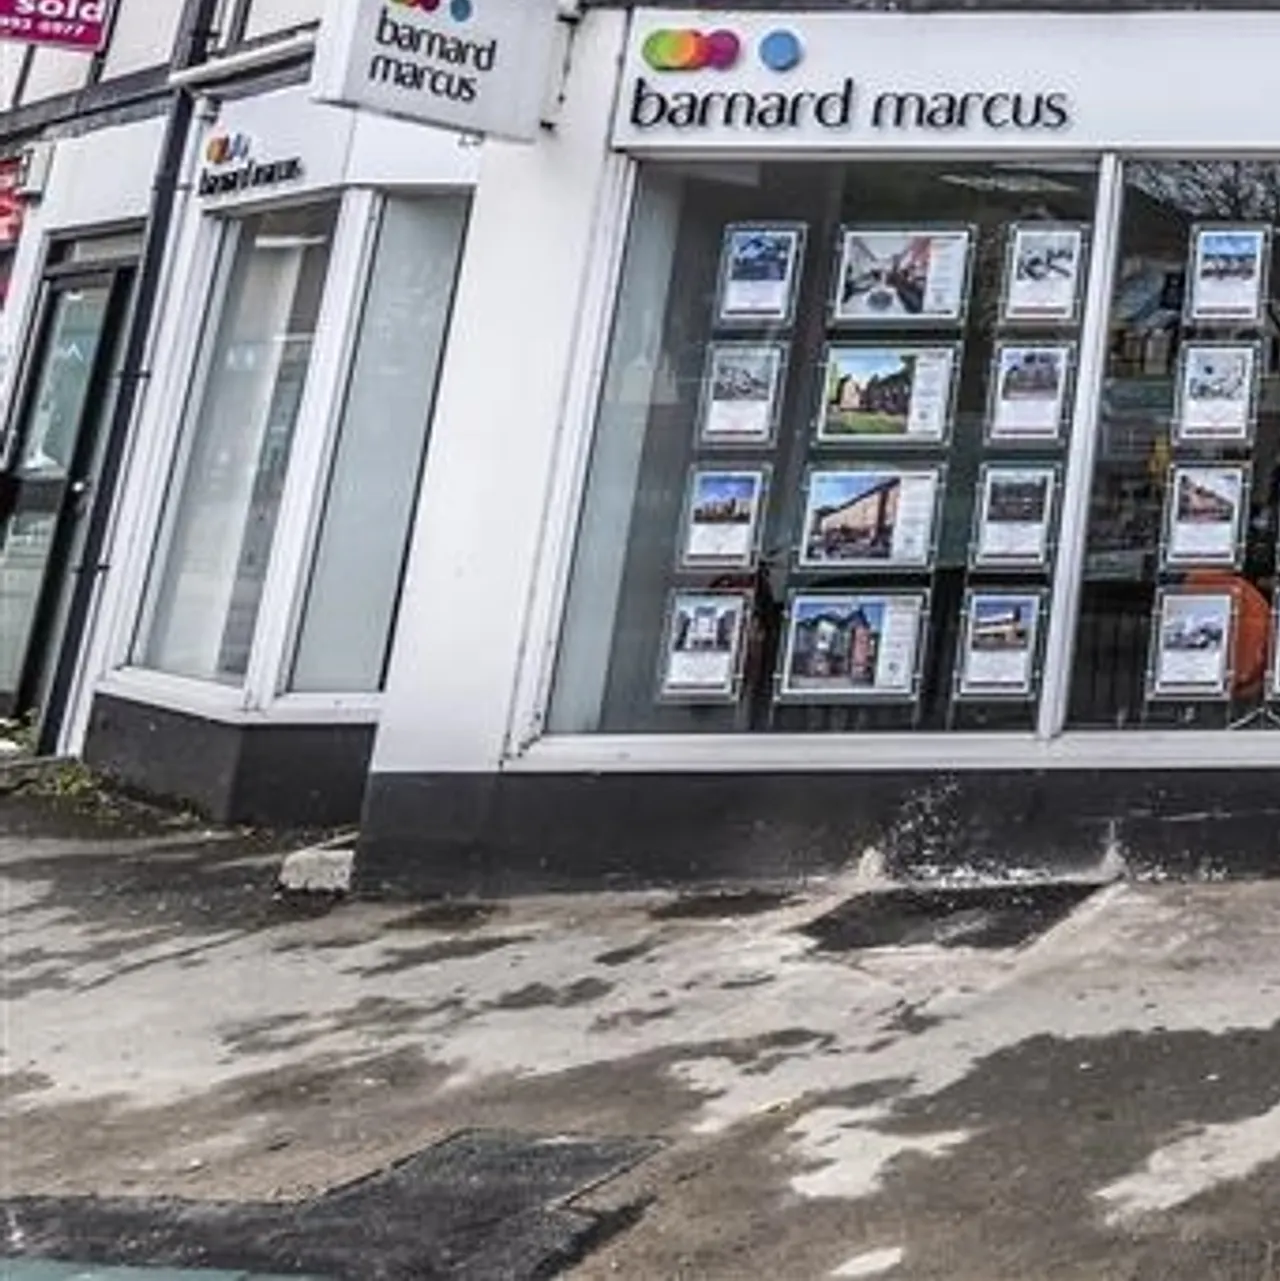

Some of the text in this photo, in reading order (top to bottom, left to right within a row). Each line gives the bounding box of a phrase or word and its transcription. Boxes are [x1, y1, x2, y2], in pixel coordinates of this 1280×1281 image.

[375, 5, 497, 72] barnard
[368, 52, 477, 102] marcus
[630, 77, 1068, 129] barnard marcus
